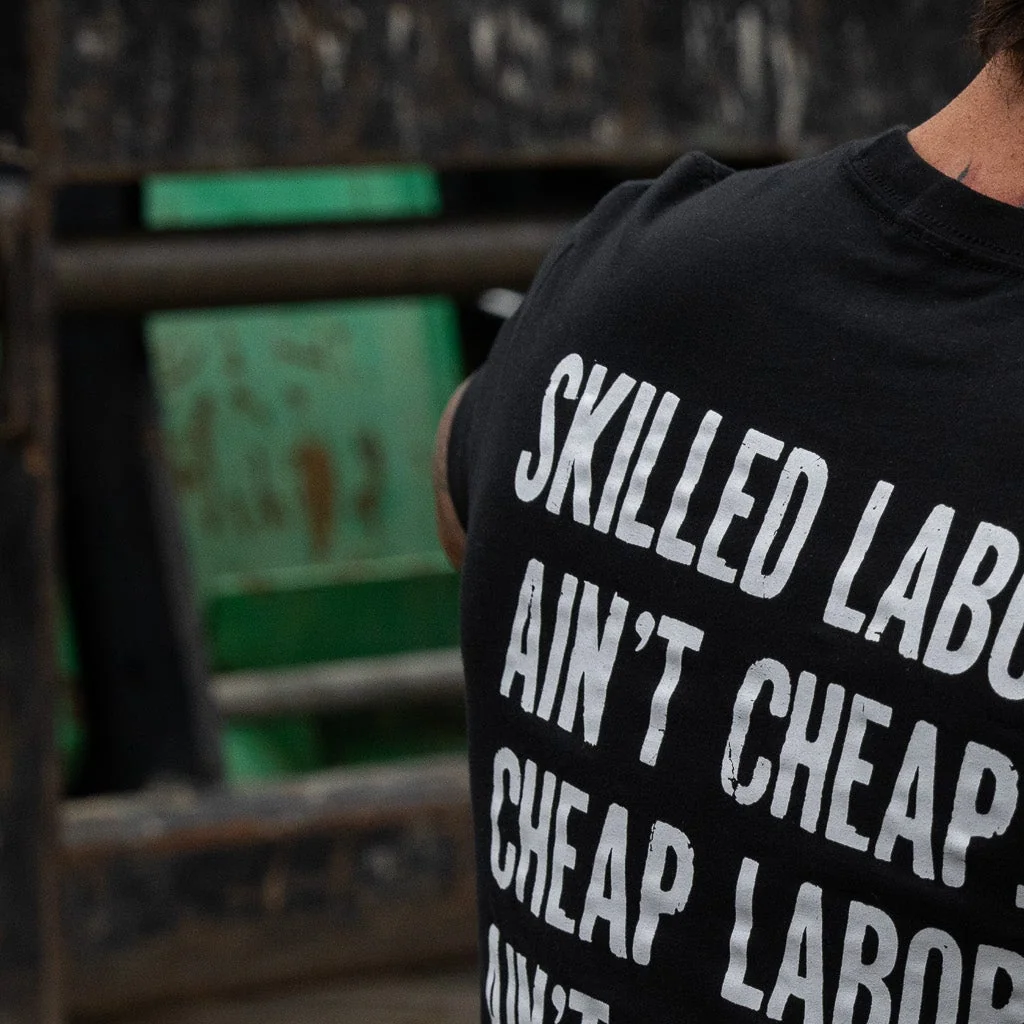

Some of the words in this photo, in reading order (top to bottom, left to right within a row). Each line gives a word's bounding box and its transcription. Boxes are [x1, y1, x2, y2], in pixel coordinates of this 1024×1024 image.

[514, 353, 829, 600] SKILLED
[500, 557, 704, 767] AIN'T
[490, 747, 695, 966] CHEAP
